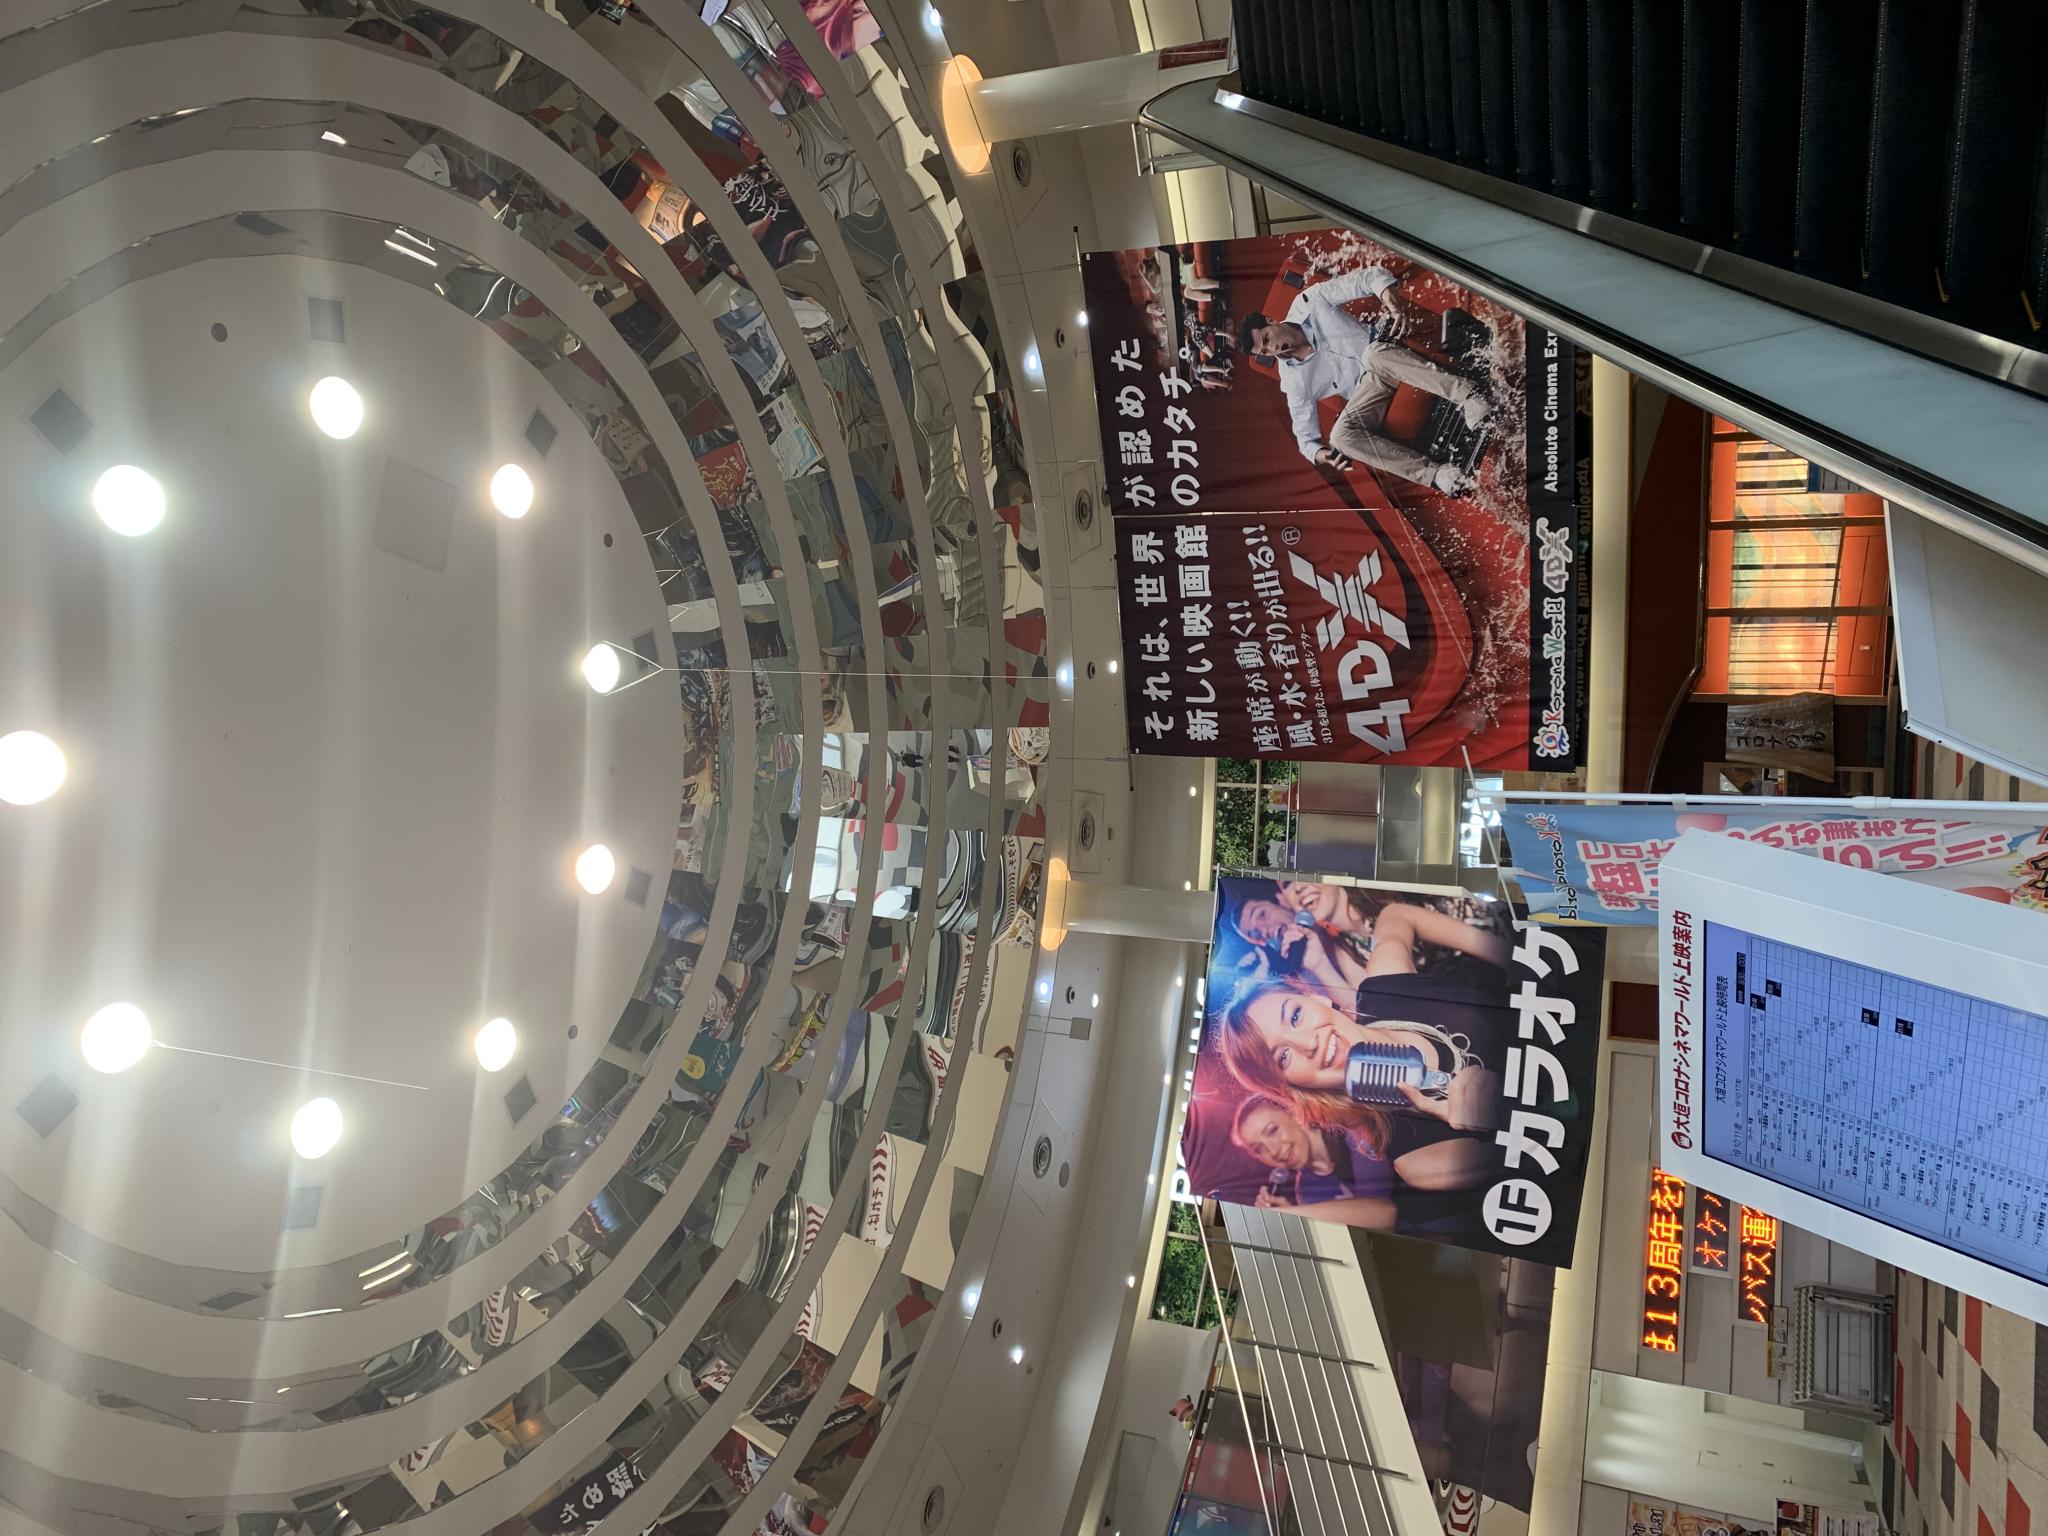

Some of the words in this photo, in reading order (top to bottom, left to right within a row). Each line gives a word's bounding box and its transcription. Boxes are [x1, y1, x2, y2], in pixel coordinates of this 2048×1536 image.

[1542, 362, 1559, 422] Cinema
[1542, 425, 1559, 493] Absolute
[1110, 337, 1174, 741] それは、世界が認めた
[1157, 344, 1220, 741] 新しい映画館のカタチ。
[1536, 517, 1572, 593] 4DX
[1289, 549, 1411, 756] 4DX
[1495, 924, 1579, 1175] カラオケ
[1672, 910, 1693, 1133] 大垣コロナシネマワールド上映案内
[1496, 1183, 1539, 1234] 1F
